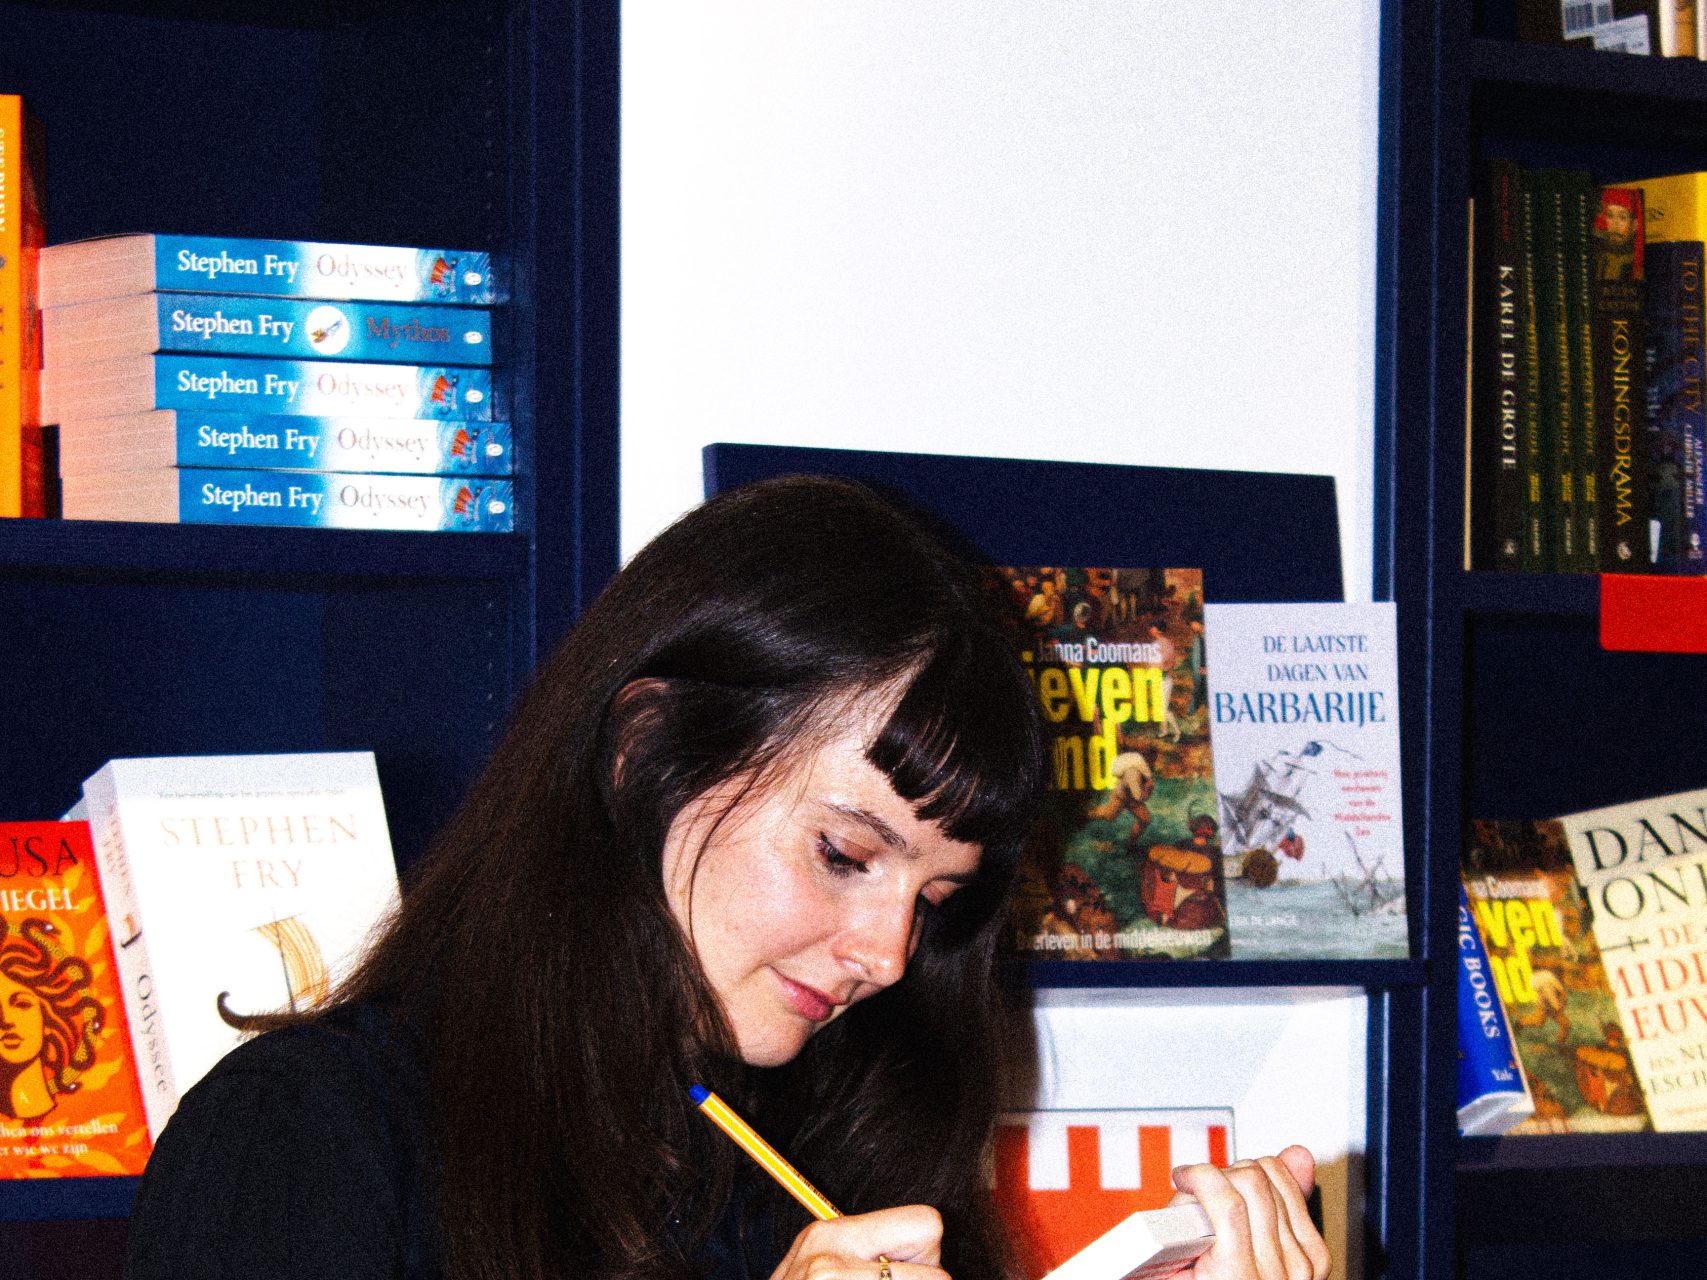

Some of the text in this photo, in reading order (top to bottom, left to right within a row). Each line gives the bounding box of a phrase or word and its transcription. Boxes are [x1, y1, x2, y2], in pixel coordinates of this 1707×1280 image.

[178, 249, 409, 287] Stephen Fry Odyssey
[1681, 257, 1699, 292] TO
[1499, 265, 1514, 344] KAREL
[173, 310, 450, 349] Stephen Fry Mythos
[177, 371, 409, 406] Stephen Fry Odyssey
[1681, 357, 1703, 416] CITY
[1501, 389, 1517, 470] GROTE
[1610, 319, 1633, 526] KONINGSDRAMA
[198, 426, 429, 460] Stephen Fry Odyssey
[201, 483, 431, 518] Stephen Fry Odyssey
[1087, 637, 1163, 664] Coomans
[1263, 634, 1369, 653] DE LAATSTE
[1267, 663, 1369, 682] DAGEN VAN
[1215, 690, 1386, 728] BARBARIJE
[158, 813, 359, 848] STEPHEN
[231, 859, 305, 889] FRY
[1602, 862, 1707, 920] ON
[1095, 929, 1111, 949] de
[1463, 957, 1500, 1039] BOOKS
[137, 974, 168, 1092] Odyssee
[58, 1119, 119, 1136] vertellen
